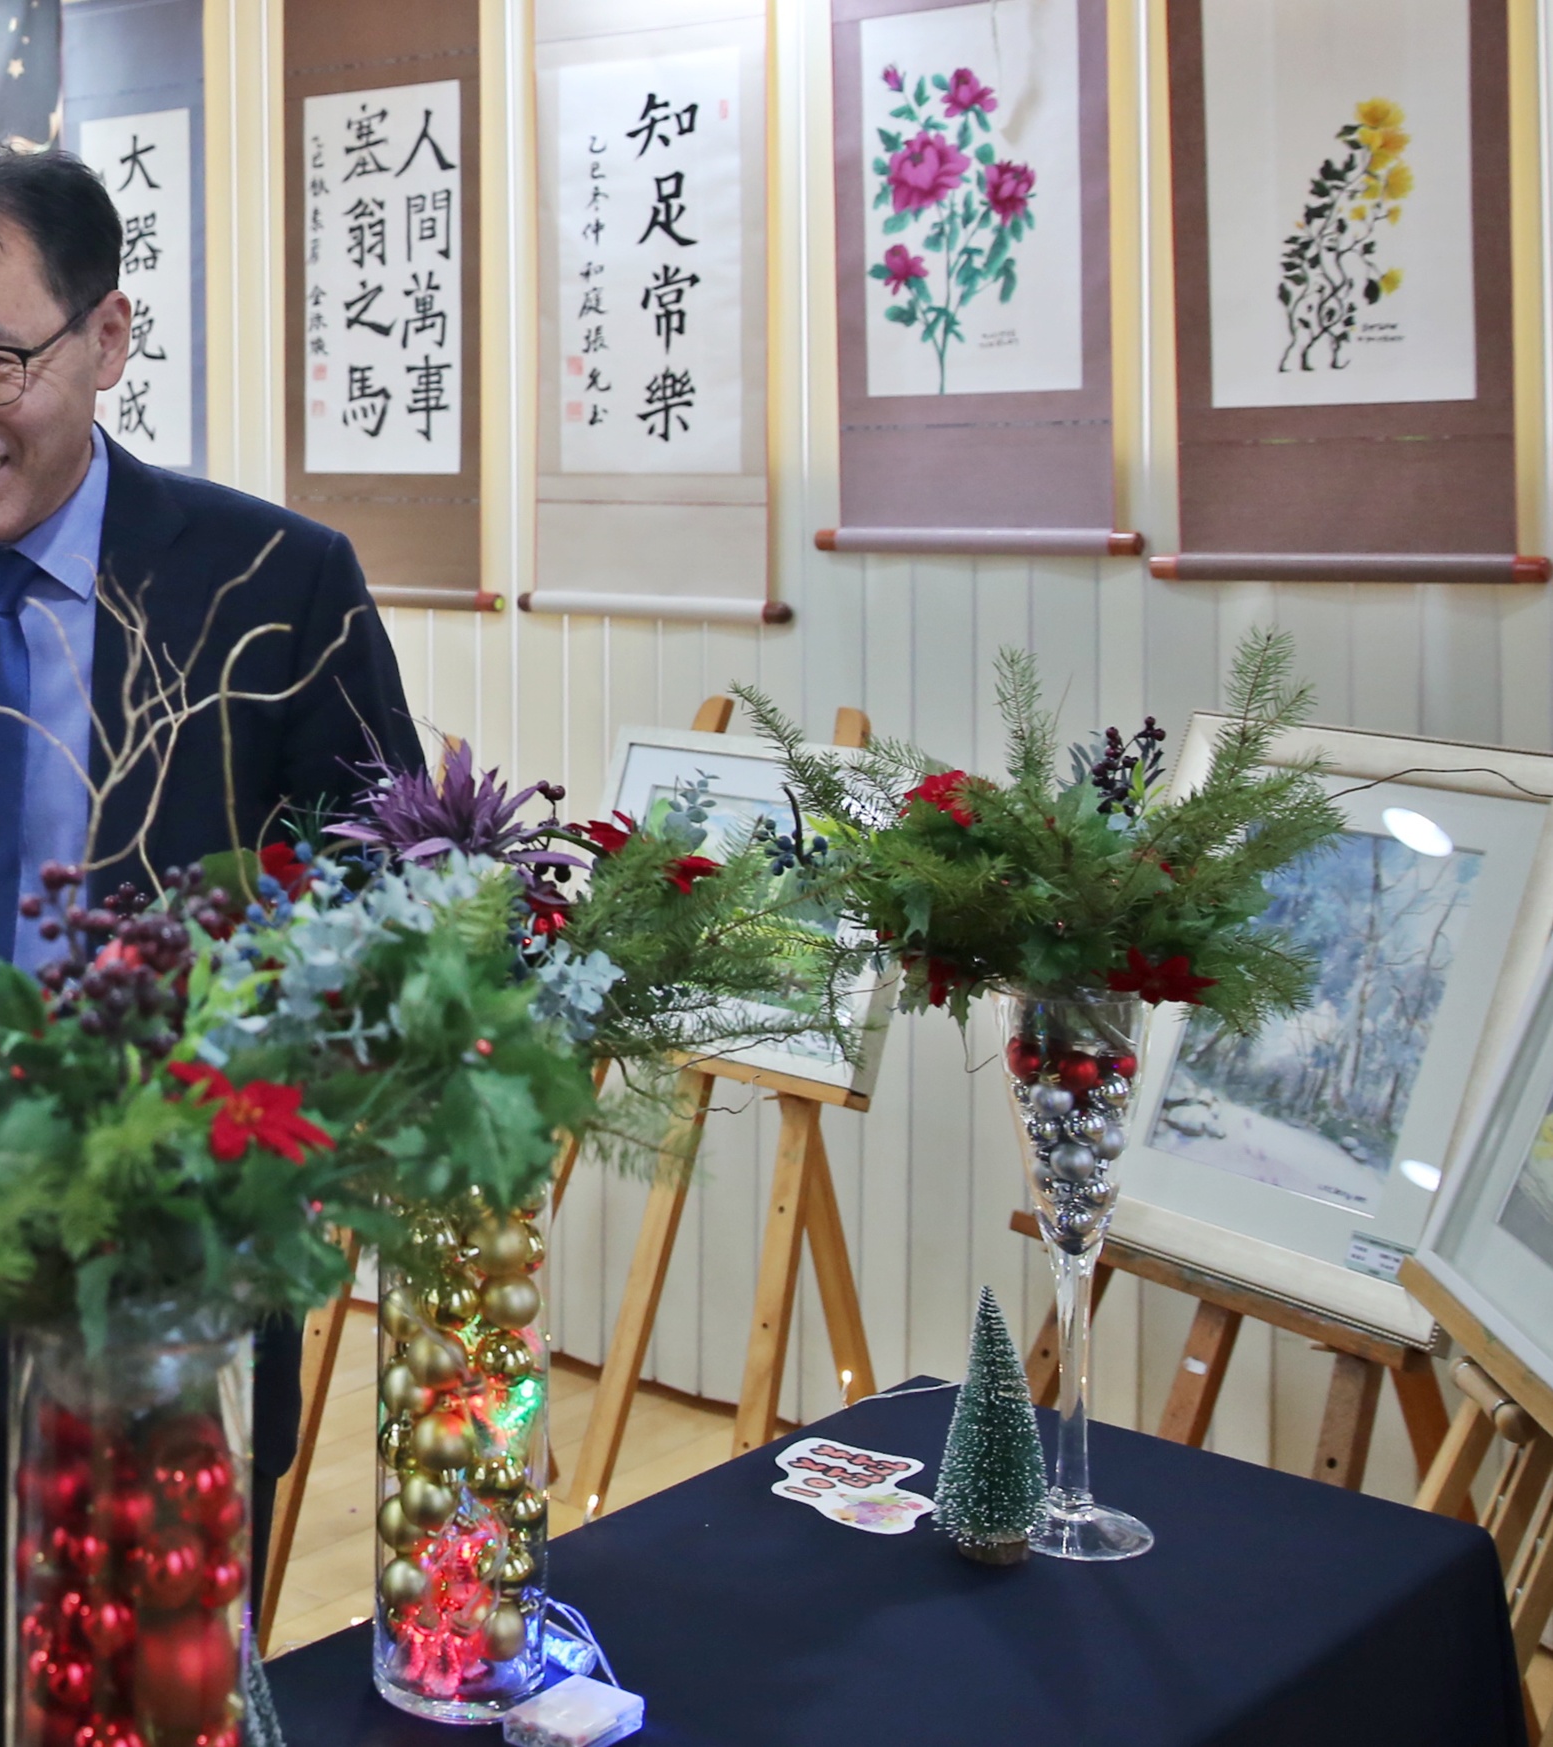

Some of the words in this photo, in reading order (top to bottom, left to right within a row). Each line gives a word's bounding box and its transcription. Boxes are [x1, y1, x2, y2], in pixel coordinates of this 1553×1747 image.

[341, 103, 398, 438] 塞翁之馬
[394, 109, 457, 442] 人間萬事
[625, 91, 700, 443] 知足常樂
